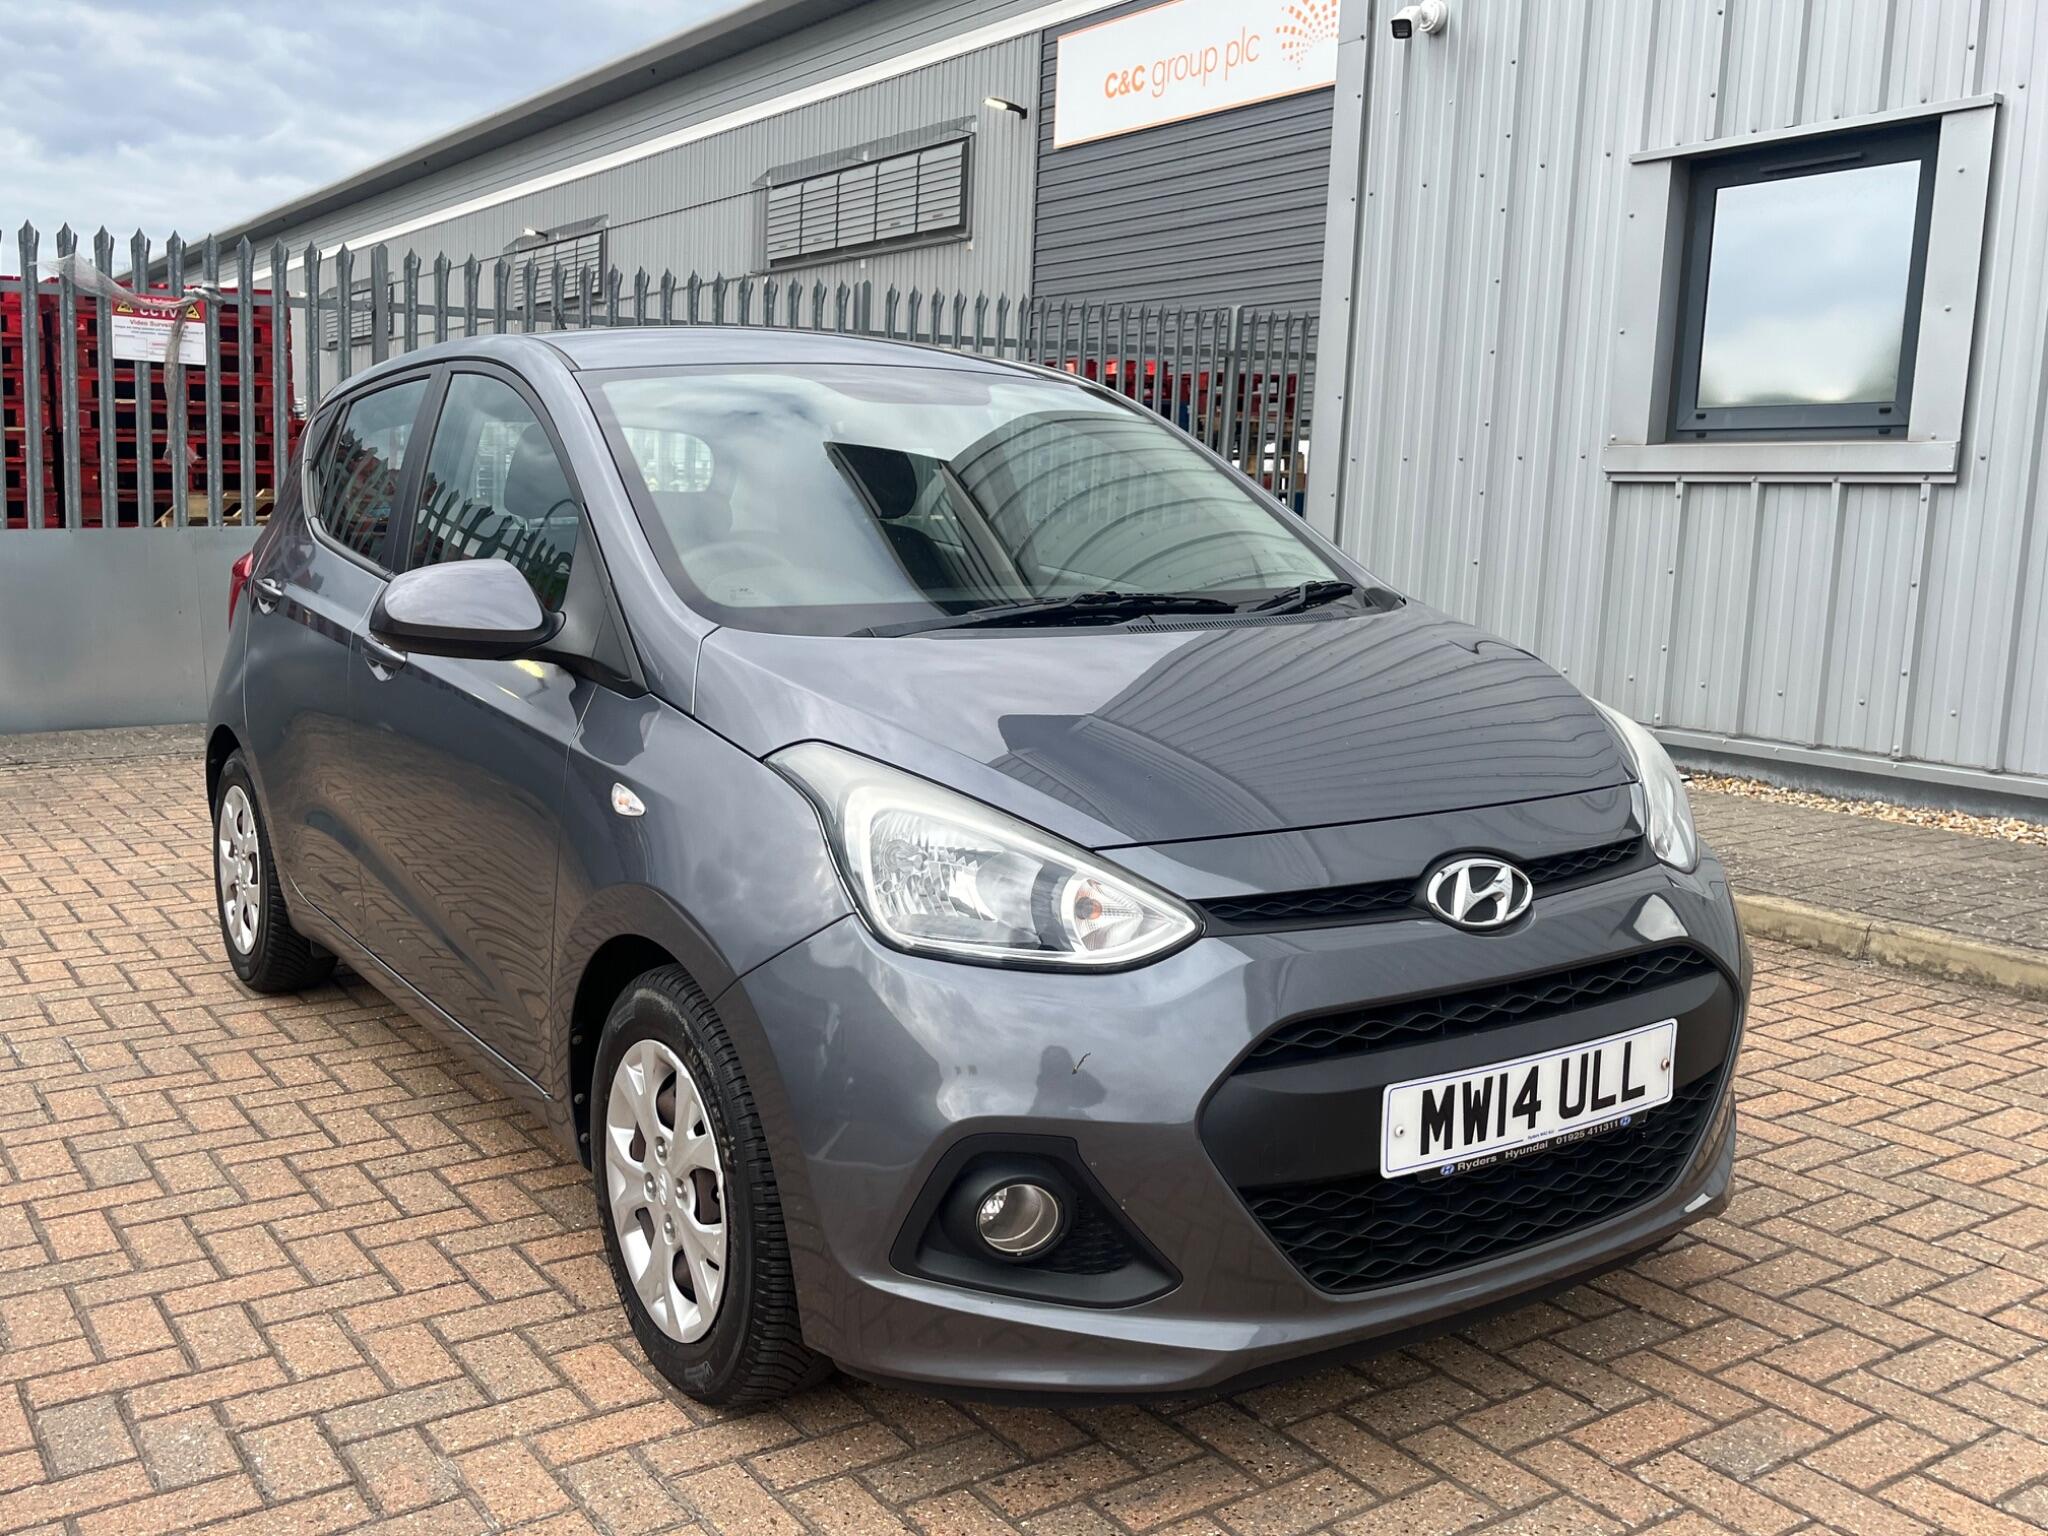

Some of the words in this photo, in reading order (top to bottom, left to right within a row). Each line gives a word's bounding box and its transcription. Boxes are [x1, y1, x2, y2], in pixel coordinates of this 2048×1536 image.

[1105, 65, 1145, 98] C&C
[1151, 47, 1217, 98] group
[1225, 27, 1260, 81] plc
[1420, 1065, 1542, 1156] MW14
[1559, 1041, 1645, 1119] ULL
[1458, 1155, 1497, 1171] Ryders
[1505, 1141, 1549, 1159] Hyundai
[1556, 1131, 1585, 1145] 01925
[1588, 1121, 1618, 1136] 411311
